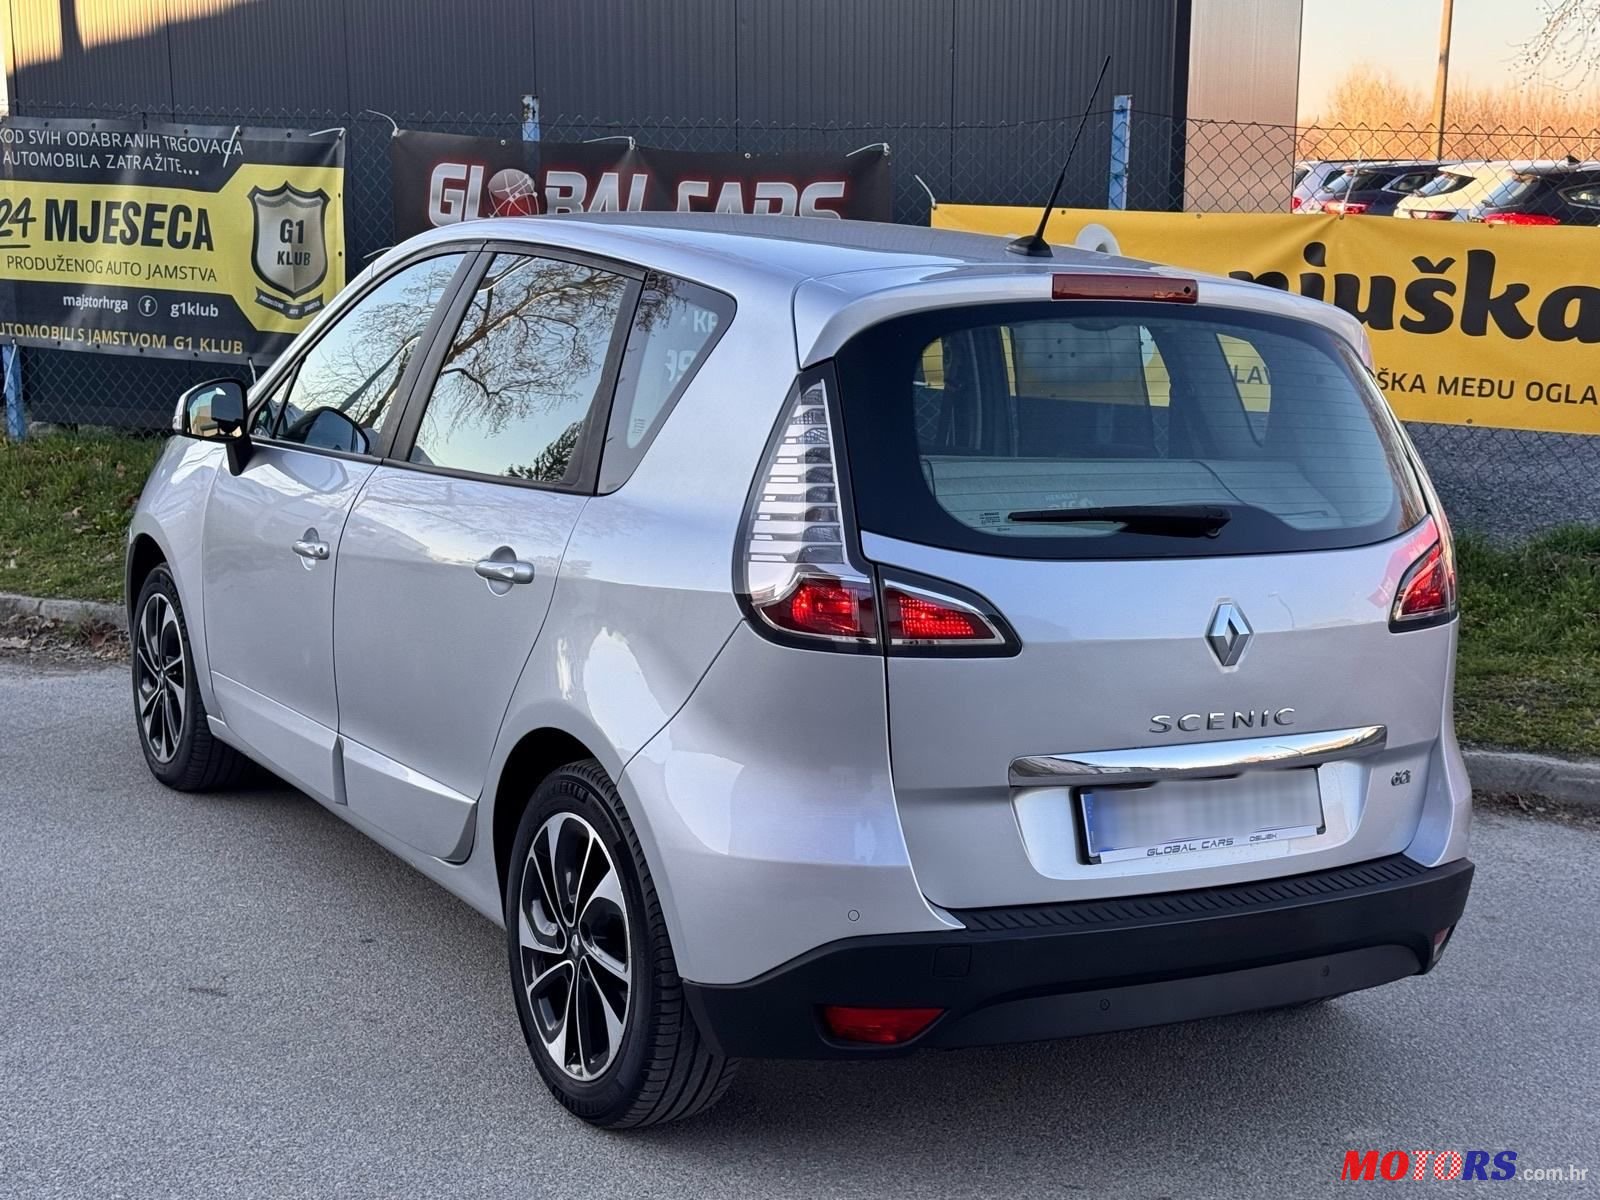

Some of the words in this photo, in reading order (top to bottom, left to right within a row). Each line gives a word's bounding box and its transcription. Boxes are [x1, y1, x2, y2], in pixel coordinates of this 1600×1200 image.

[29, 130, 61, 145] SVIH
[66, 131, 160, 149] ODABRANIH
[3, 151, 100, 169] AUTOMOBILA
[45, 198, 214, 252] MJESECA
[280, 218, 304, 244] G1
[7, 254, 103, 274] PRODUŽENOG
[106, 261, 142, 277] AUTO
[145, 263, 217, 282] JAMSTVA
[277, 250, 311, 266] KLUB
[63, 293, 129, 313] majstorhrga
[170, 302, 219, 318] g1klub
[78, 328, 85, 342] S
[87, 329, 167, 349] JAMSTVOM
[173, 336, 193, 351] G1
[200, 338, 243, 355] KLUB
[1437, 375, 1515, 400] MEĐU
[1149, 707, 1296, 733] SCENIC
[1146, 843, 1197, 857] GLOBAL
[1201, 838, 1234, 849] CARS
